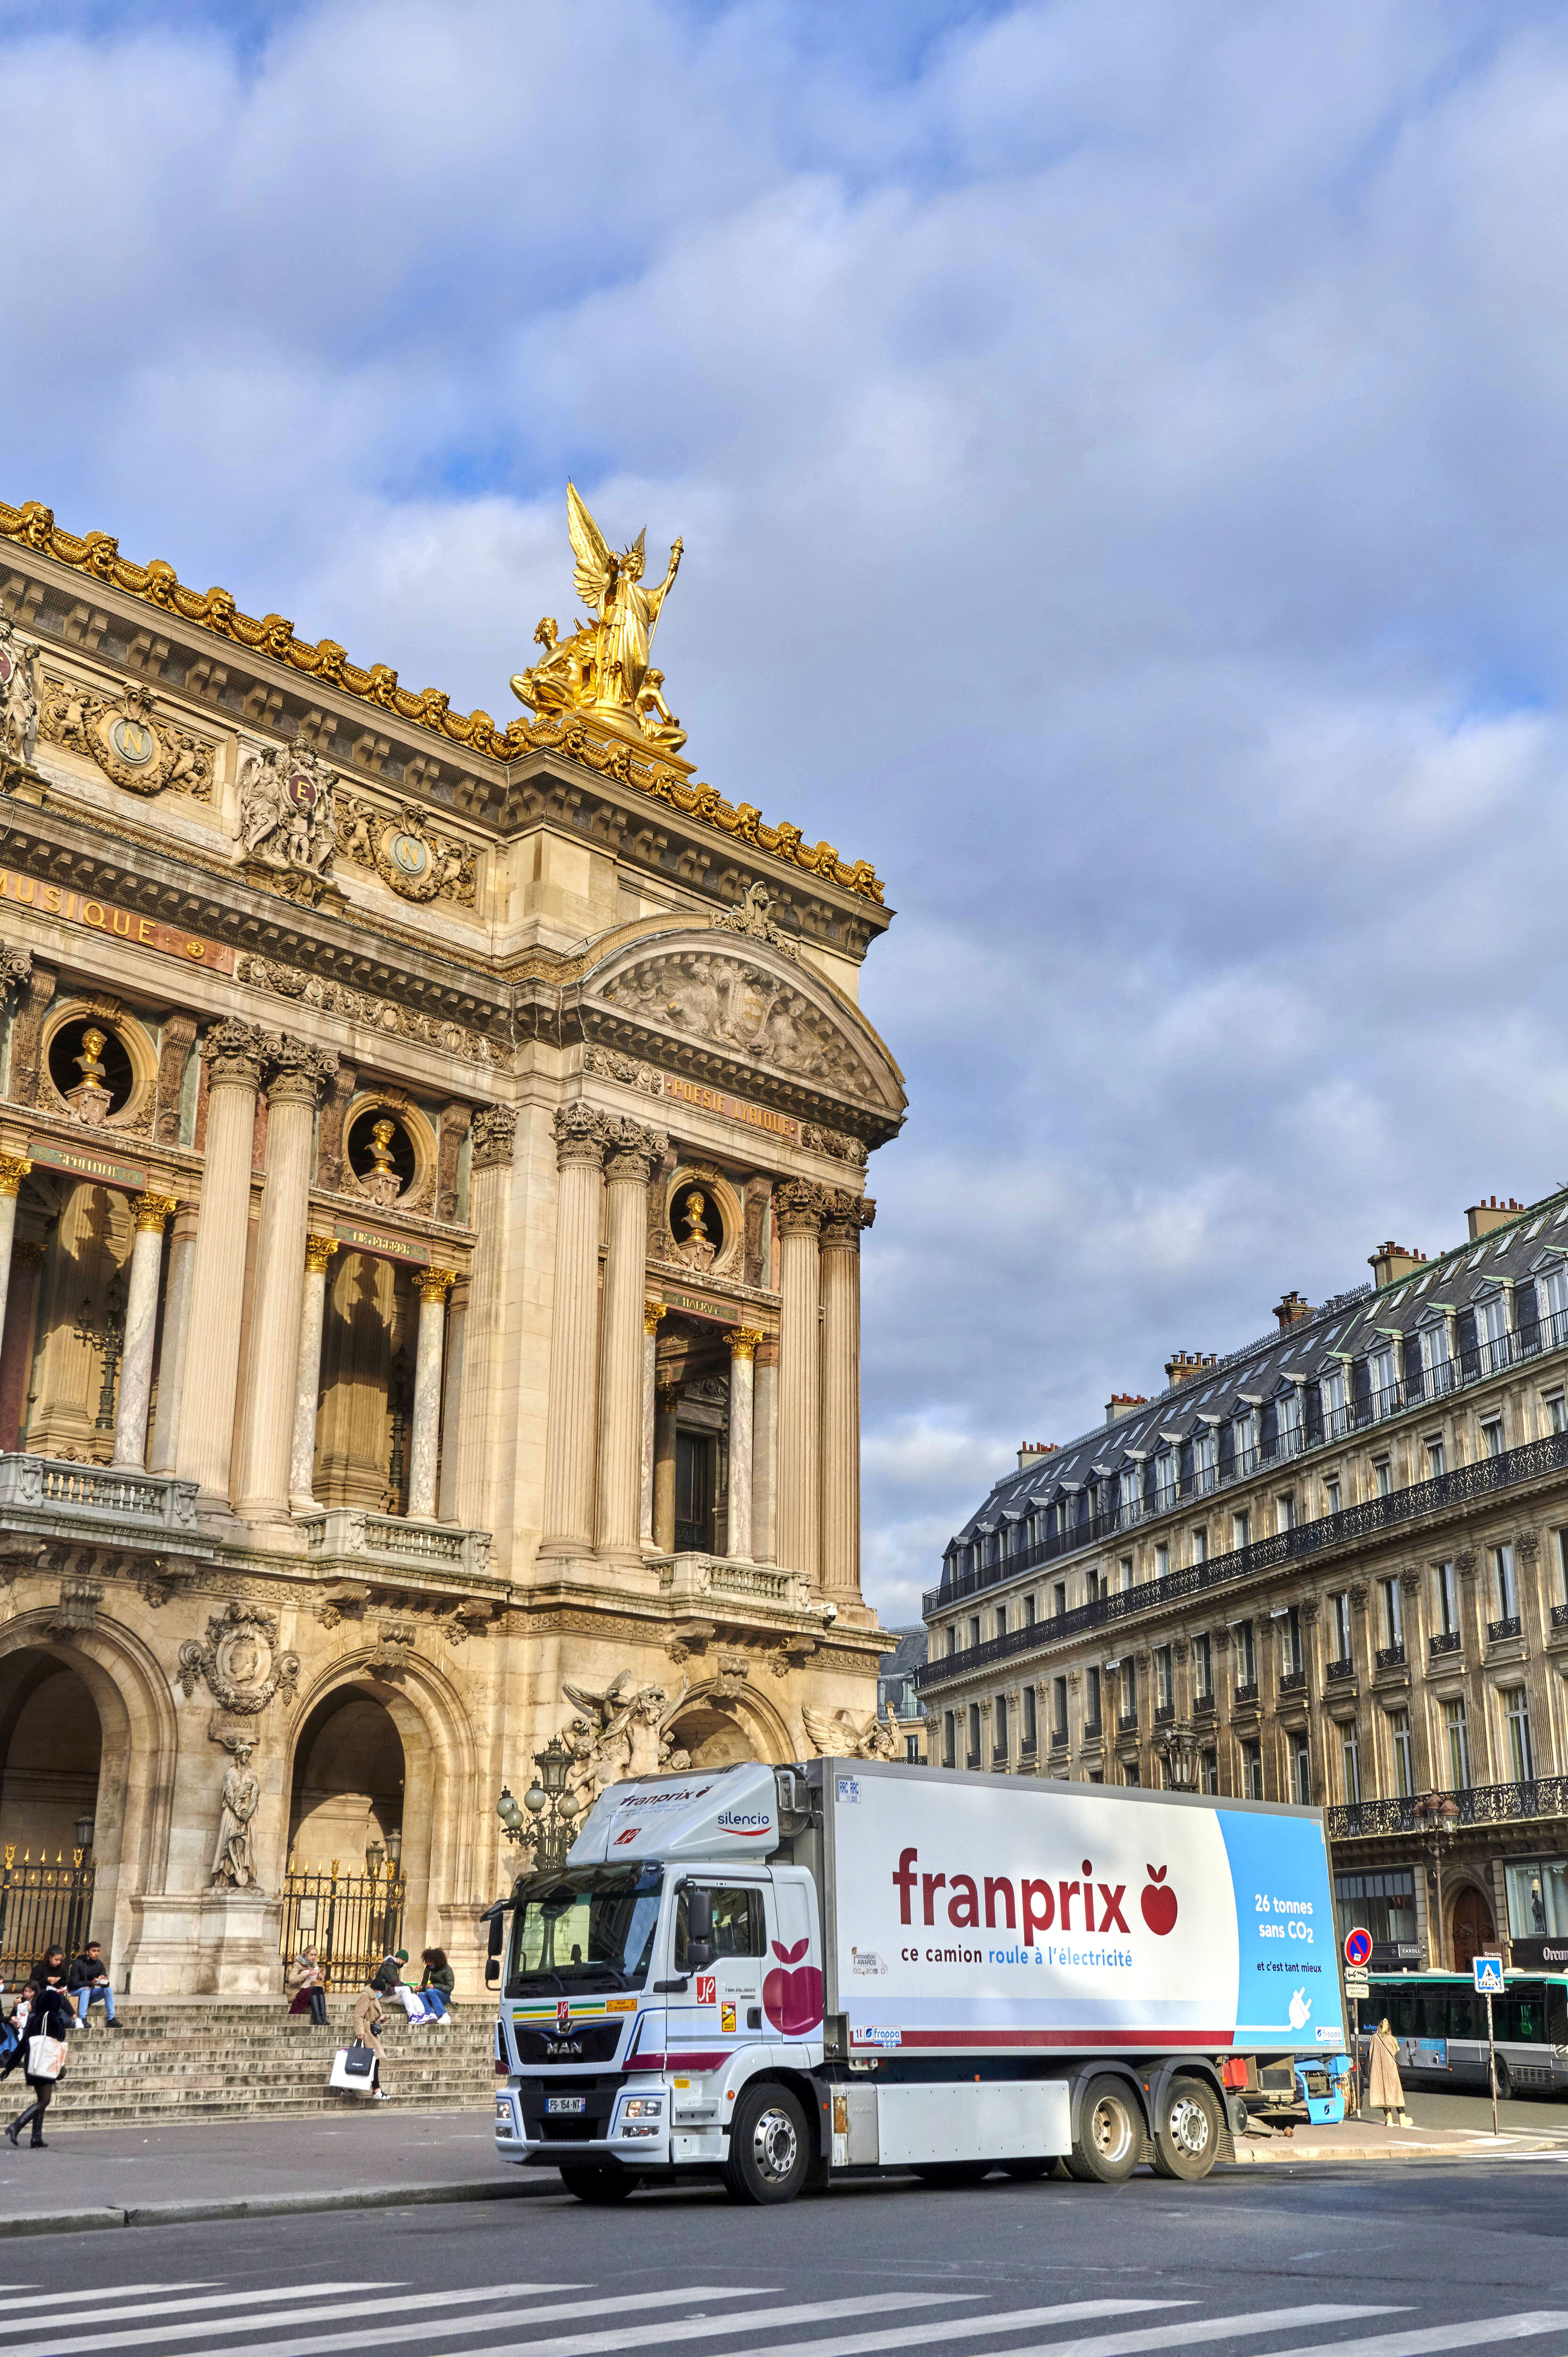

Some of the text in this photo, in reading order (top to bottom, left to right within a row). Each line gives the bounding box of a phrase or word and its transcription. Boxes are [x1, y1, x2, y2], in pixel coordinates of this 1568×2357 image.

[123, 727, 143, 754] N
[297, 781, 309, 801] E
[403, 841, 418, 865] N
[674, 1079, 789, 1136] POESIE LYRIQUE
[619, 1788, 695, 1806] franprix
[718, 1811, 769, 1824] silencio
[893, 1847, 1131, 1947] franprix
[1255, 1894, 1314, 1915] 26 tonnes
[1259, 1924, 1285, 1938] sans
[901, 1944, 1133, 1967] ce camion roule à l'électricité
[1257, 1961, 1322, 1973] et c'est tant mieux
[874, 2028, 900, 2039] frappa
[1323, 2029, 1341, 2038] frappa
[547, 2042, 583, 2055] MAN
